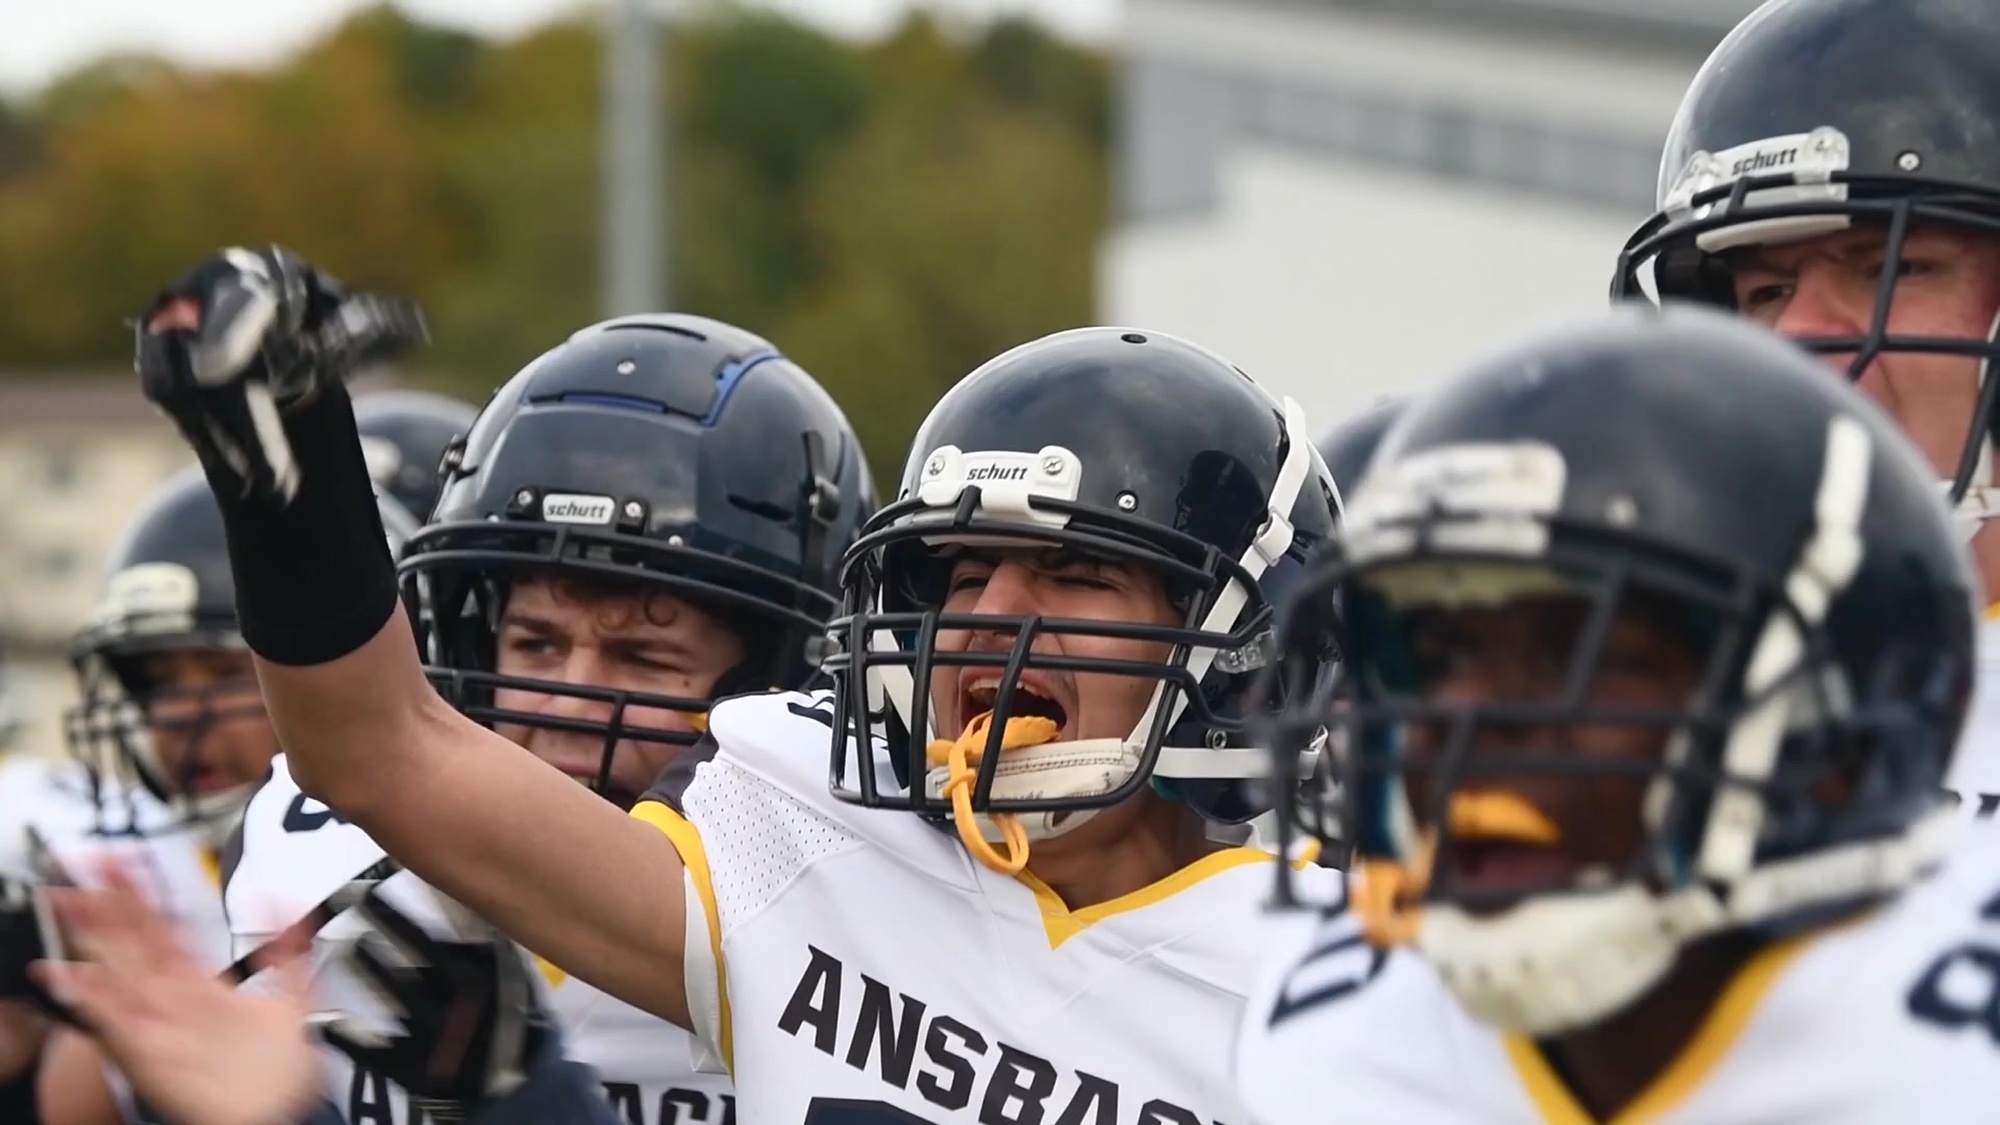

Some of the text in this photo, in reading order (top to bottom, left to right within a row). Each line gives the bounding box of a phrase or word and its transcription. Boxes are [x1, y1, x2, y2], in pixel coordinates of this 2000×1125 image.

[1731, 147, 1798, 176] schutt
[966, 462, 1029, 481] schutt
[546, 501, 606, 518] schutt
[777, 943, 1228, 1125] ANSBA
